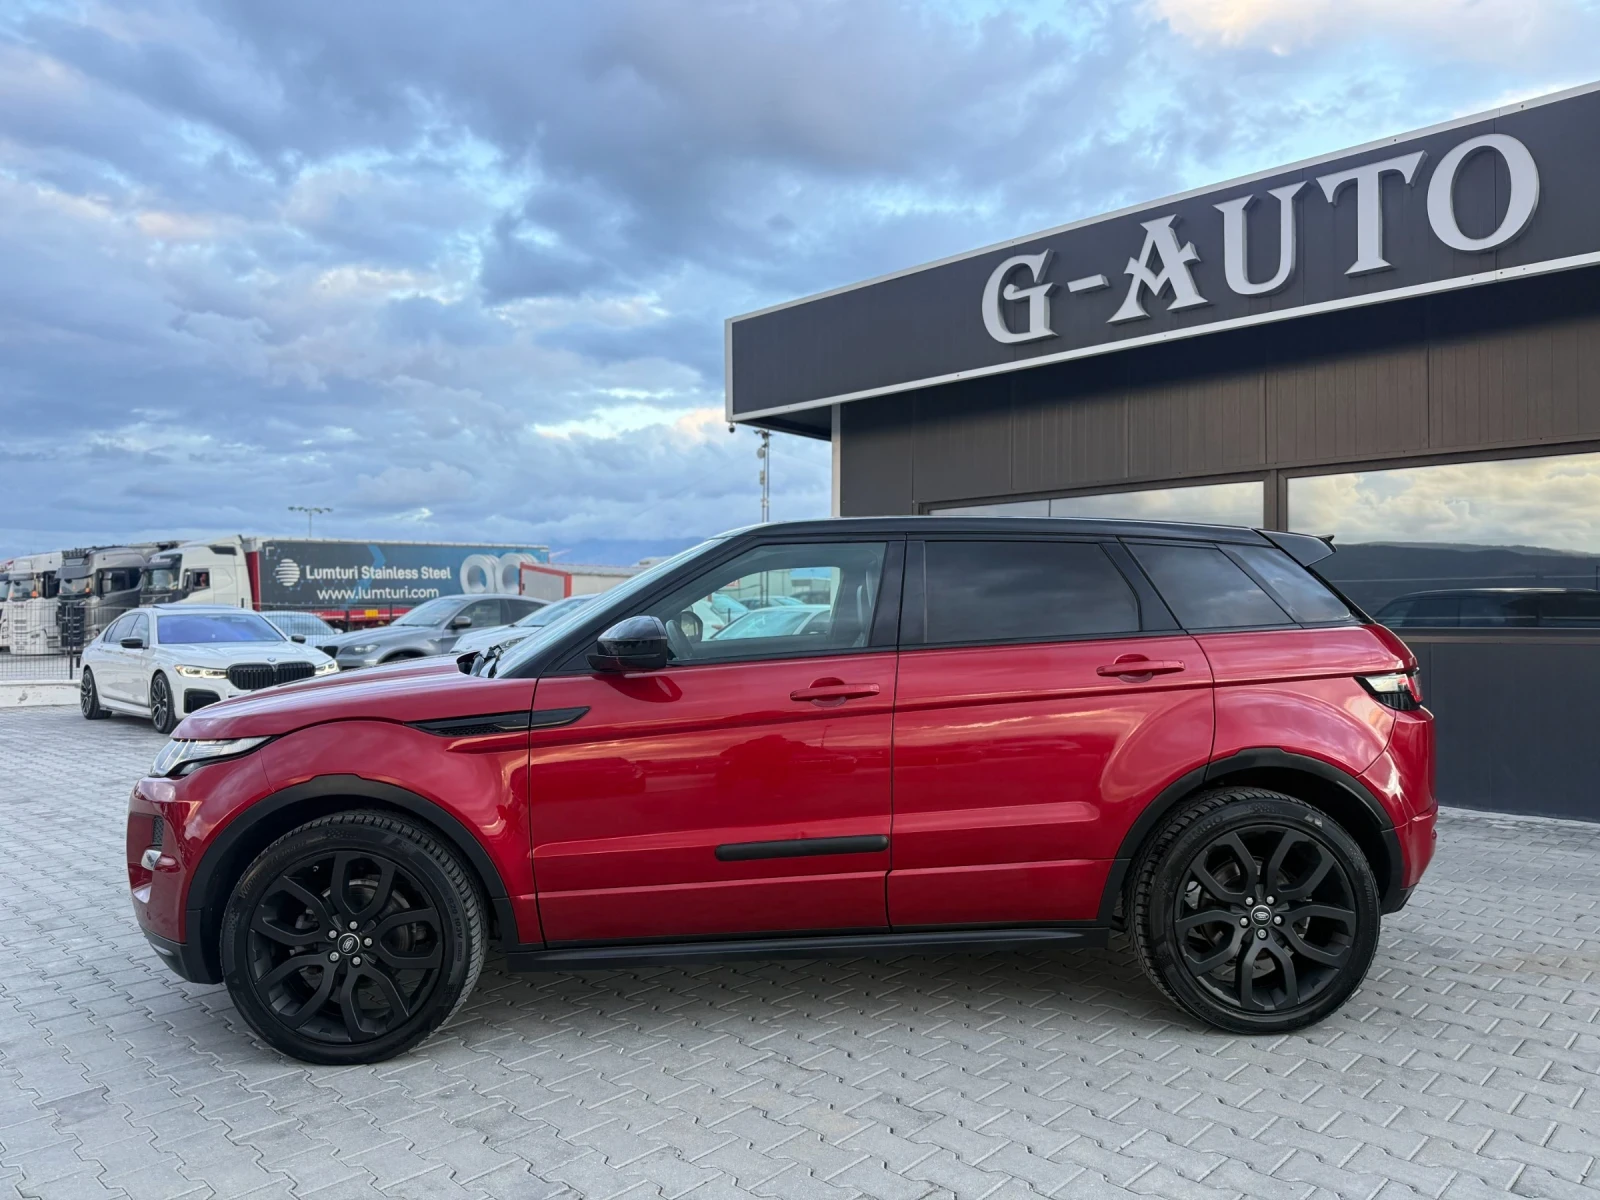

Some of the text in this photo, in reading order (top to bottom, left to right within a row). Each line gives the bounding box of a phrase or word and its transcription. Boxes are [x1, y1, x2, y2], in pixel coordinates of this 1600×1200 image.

[982, 133, 1541, 345] G-AUTO
[306, 566, 452, 580] Lumturi Stainless Steel
[316, 585, 439, 600] www.lumturi.com
